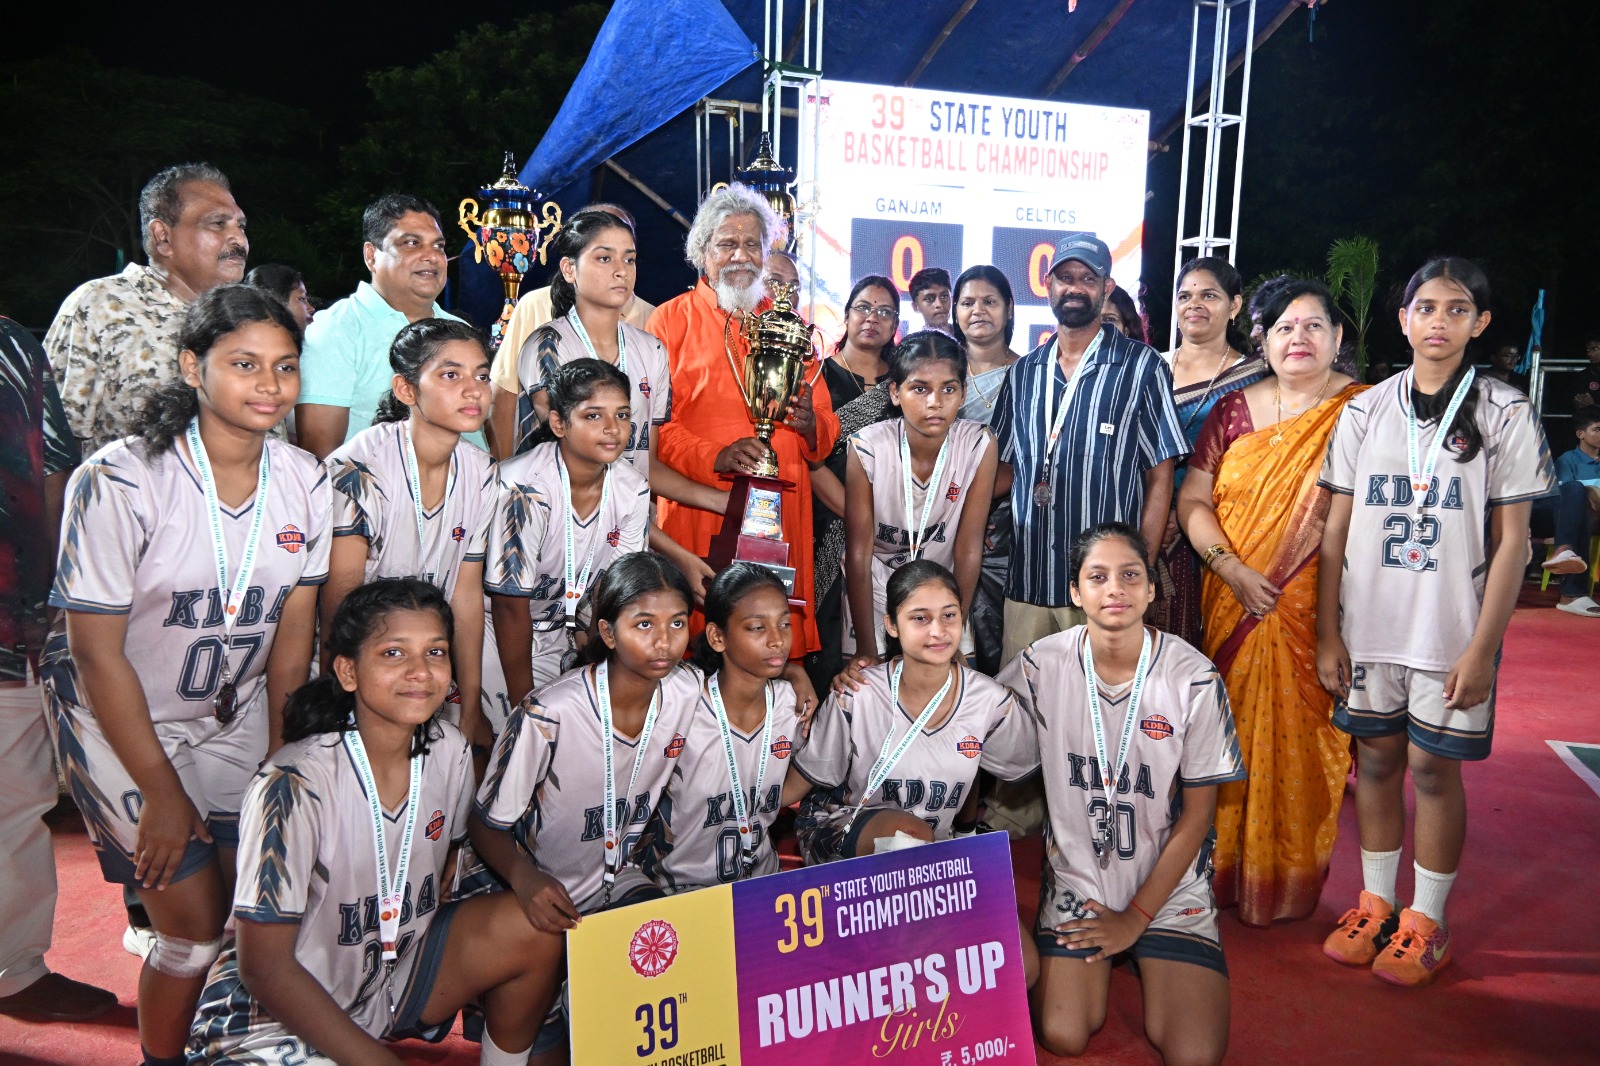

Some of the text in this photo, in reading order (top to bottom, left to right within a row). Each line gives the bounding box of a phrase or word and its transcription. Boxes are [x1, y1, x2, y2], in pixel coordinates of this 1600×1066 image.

[871, 93, 905, 130] 39
[930, 100, 992, 136] STATE
[1002, 108, 1067, 143] YOUTH
[844, 131, 1109, 181] BASKETBALL CHAMPIONSHIP
[876, 197, 942, 216] GANJAM
[1016, 207, 1076, 224] CELTICS
[892, 235, 924, 292] 0
[1365, 474, 1464, 510] KDBA
[1381, 512, 1442, 571] 22
[176, 631, 265, 701] 07
[601, 695, 609, 736] CHAMPIONSHIP
[1089, 685, 1098, 714] BASKETBALL
[1128, 690, 1138, 719] BASKETBALL
[773, 742, 791, 751] KDBA
[871, 773, 884, 789] ODISHA
[882, 759, 894, 774] STATE
[891, 746, 904, 761] YOUTH
[901, 721, 921, 747] BASKETBALL
[919, 692, 943, 722] CHAMPIONSHIP
[1143, 720, 1170, 731] KDBA
[354, 747, 374, 793] CHAMPIONSHIP
[724, 736, 734, 765] BASKETBALL
[882, 779, 965, 811] KDBA
[1068, 753, 1155, 799] KDBA
[371, 794, 381, 832] BASKETBALL
[1087, 797, 1136, 860] 30
[395, 869, 404, 893] ODISHA
[408, 784, 417, 824] BASKETBALL
[775, 857, 973, 954] 39 TH STATE YOUTH BASKETBALL
[837, 879, 977, 938] CHAMPIONSHIP
[757, 941, 1005, 1048] RUNNER'S UP
[635, 996, 679, 1057] 39
[679, 992, 687, 1004] TH
[872, 991, 967, 1058] Girls
[961, 1036, 1015, 1066] 5,000/-
